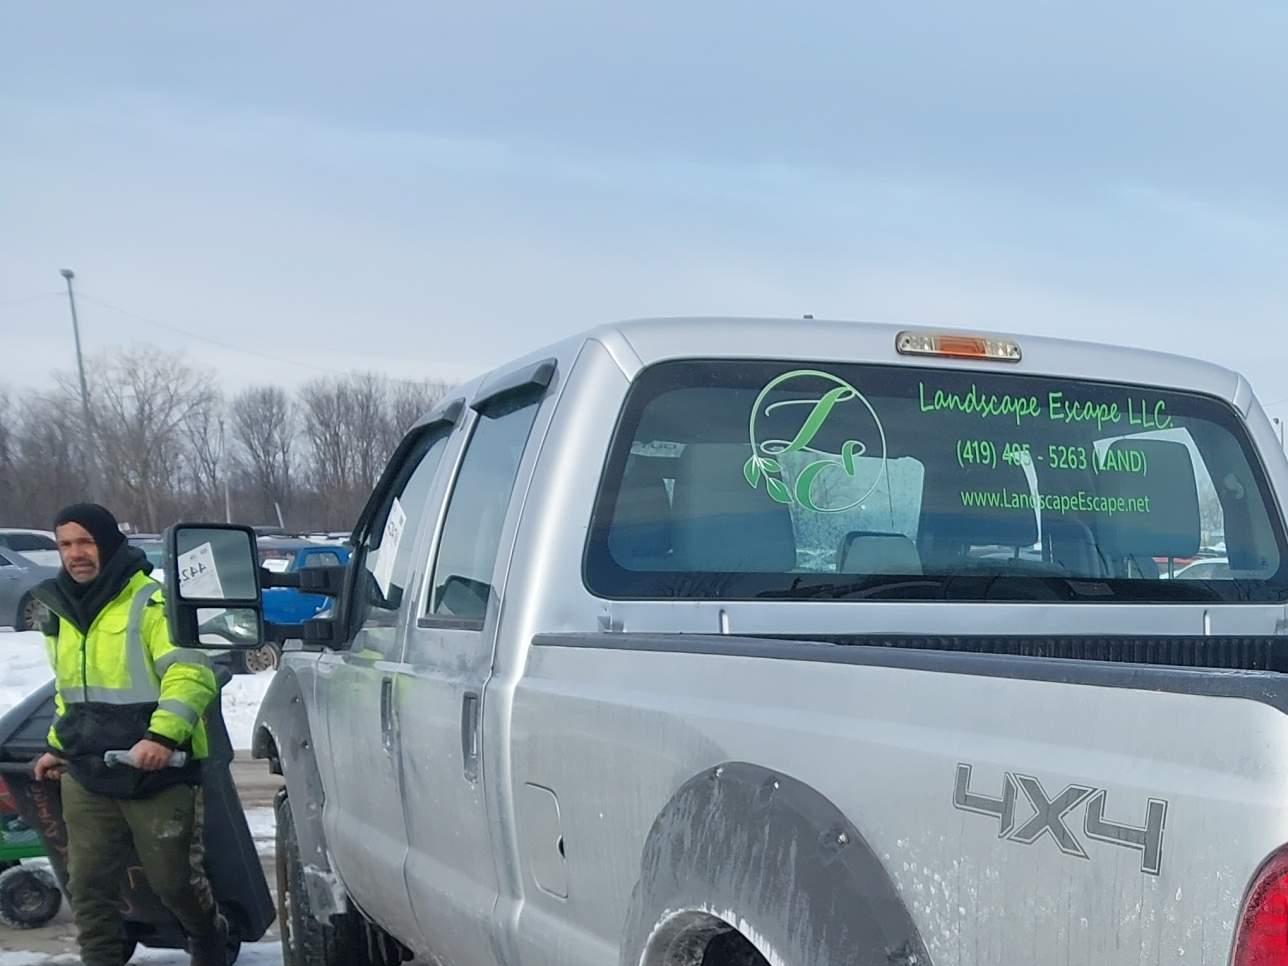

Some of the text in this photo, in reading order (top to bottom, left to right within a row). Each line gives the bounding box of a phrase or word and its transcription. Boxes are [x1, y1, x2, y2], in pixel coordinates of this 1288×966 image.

[919, 381, 1041, 426] Landscape
[1048, 391, 1121, 432] Escape
[956, 439, 997, 470] (419)
[1048, 445, 1088, 470] 5263
[960, 487, 1151, 516] www.LandscapeEscape.net
